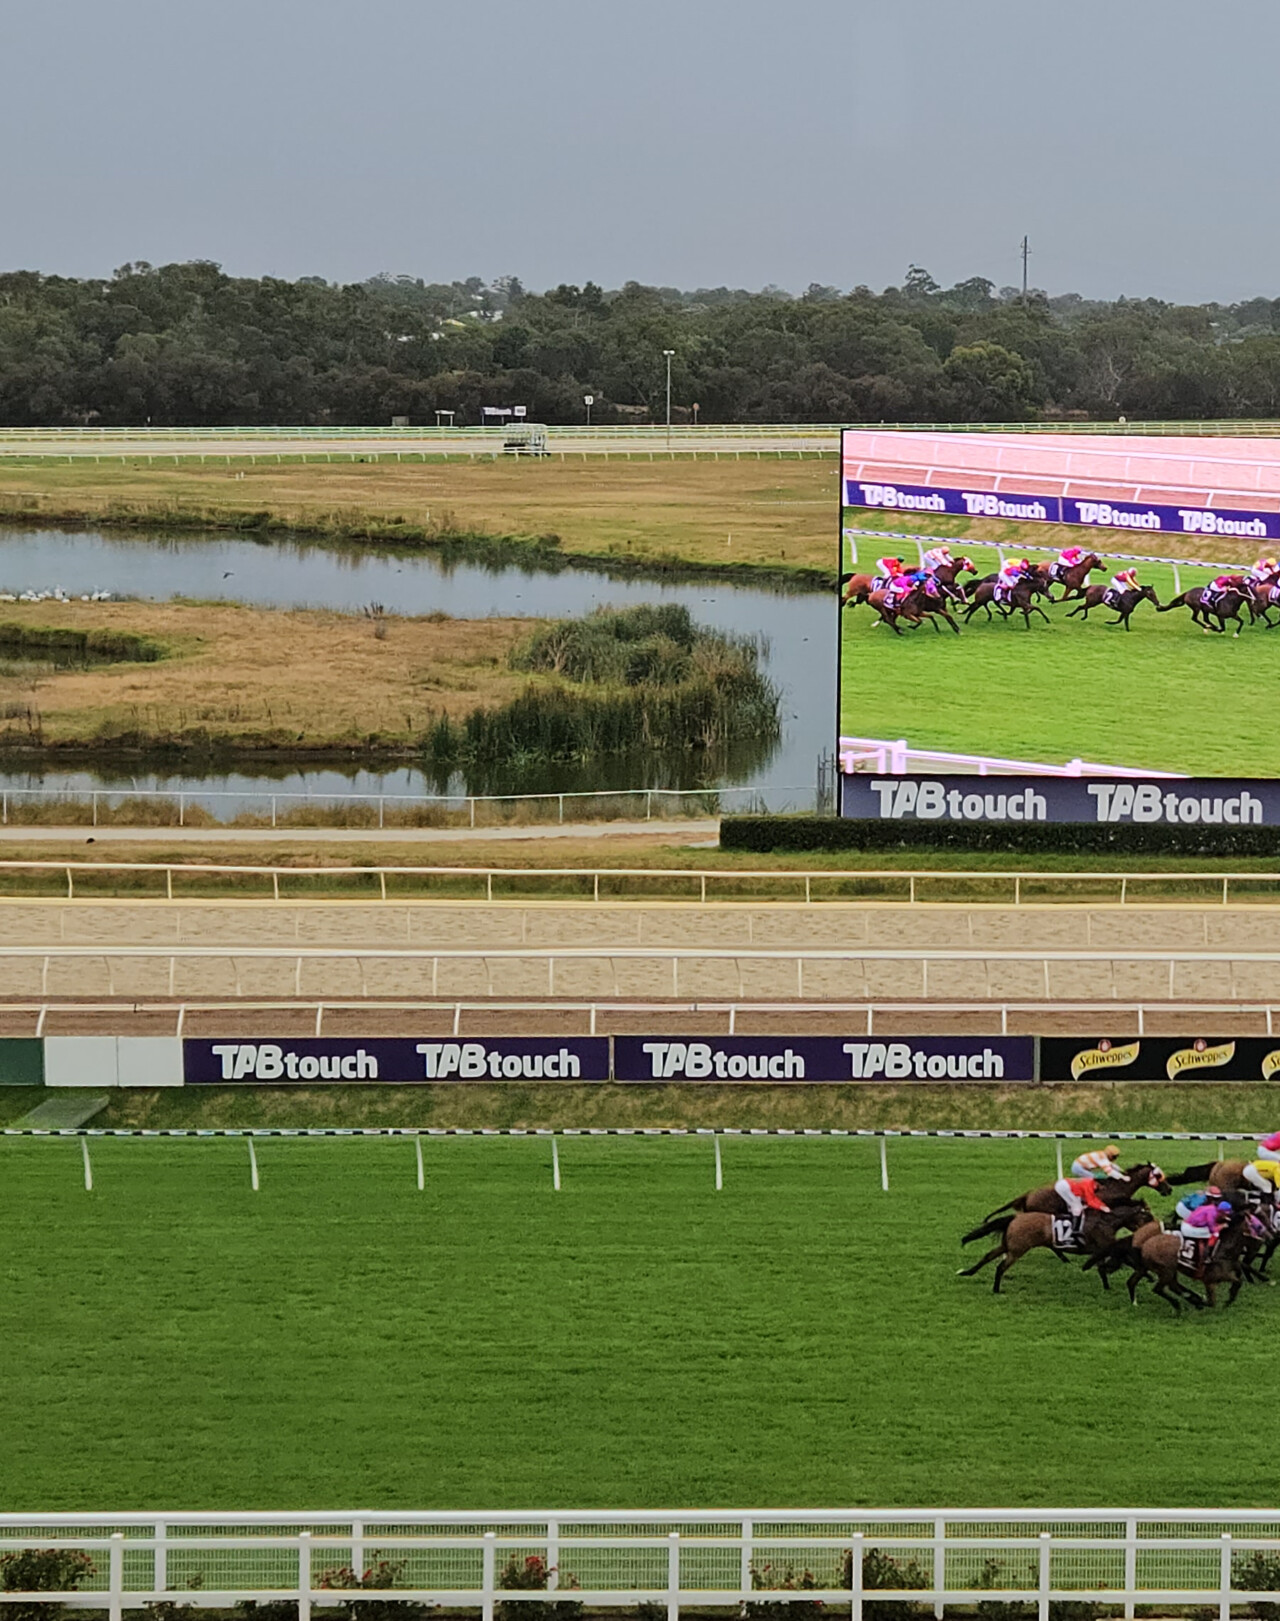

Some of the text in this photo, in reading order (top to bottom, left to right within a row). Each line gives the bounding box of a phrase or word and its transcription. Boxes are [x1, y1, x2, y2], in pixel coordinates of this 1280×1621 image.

[859, 484, 946, 511] TABtouch
[961, 493, 1047, 519] TABtouch
[1075, 502, 1161, 529] TABtouch
[1178, 510, 1267, 537] TABtouch
[870, 780, 1047, 821] TABtouch
[1087, 783, 1263, 825] TABtouch
[211, 1044, 378, 1080] TABtouch
[415, 1043, 581, 1079] TABtouch
[642, 1042, 805, 1079] TABtouch
[842, 1043, 1004, 1079] TABtouch
[1079, 1049, 1133, 1069] Schweppes
[1174, 1049, 1229, 1069] Schweppes
[1054, 1219, 1074, 1242] 12
